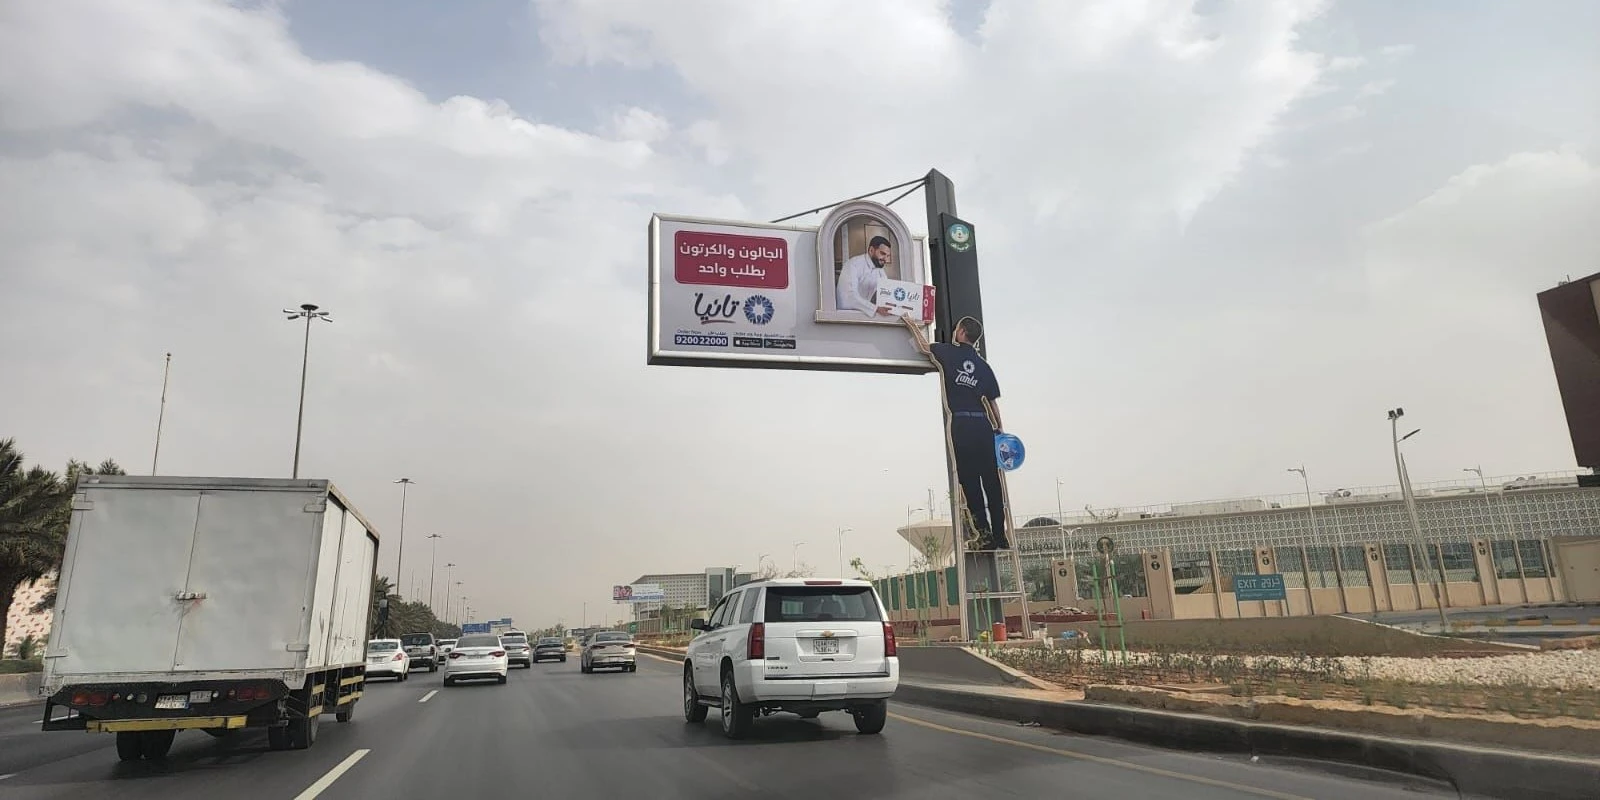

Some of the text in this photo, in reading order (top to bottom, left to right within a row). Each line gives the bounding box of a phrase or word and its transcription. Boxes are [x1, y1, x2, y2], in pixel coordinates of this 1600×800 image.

[680, 242, 783, 262] الجالون والكرتون
[698, 262, 766, 280] بطلب واحد
[694, 292, 740, 321] تانيا
[1237, 579, 1257, 589] EXIT
